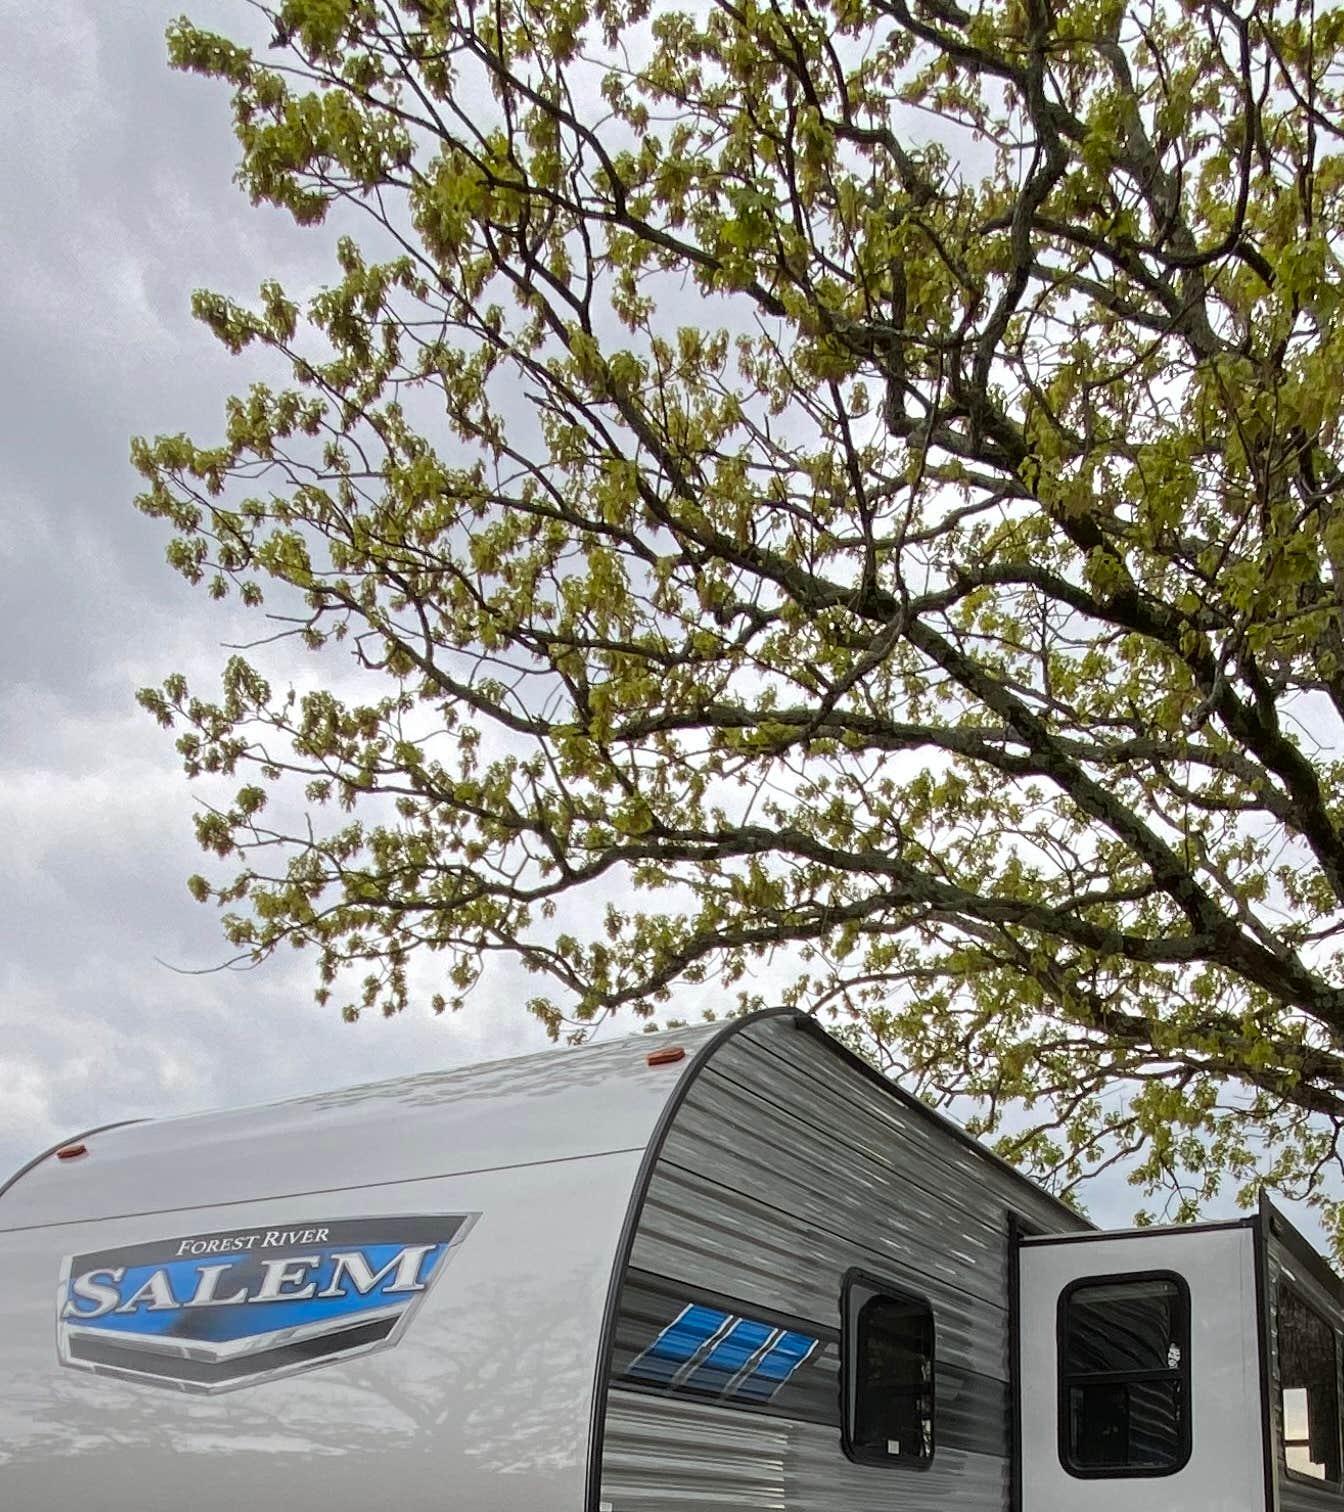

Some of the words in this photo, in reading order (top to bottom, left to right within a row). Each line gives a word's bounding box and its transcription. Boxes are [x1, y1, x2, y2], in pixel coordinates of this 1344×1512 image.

[176, 1235, 260, 1257] FOREST
[261, 1227, 329, 1250] RIVER
[62, 1244, 438, 1320] SALEM
